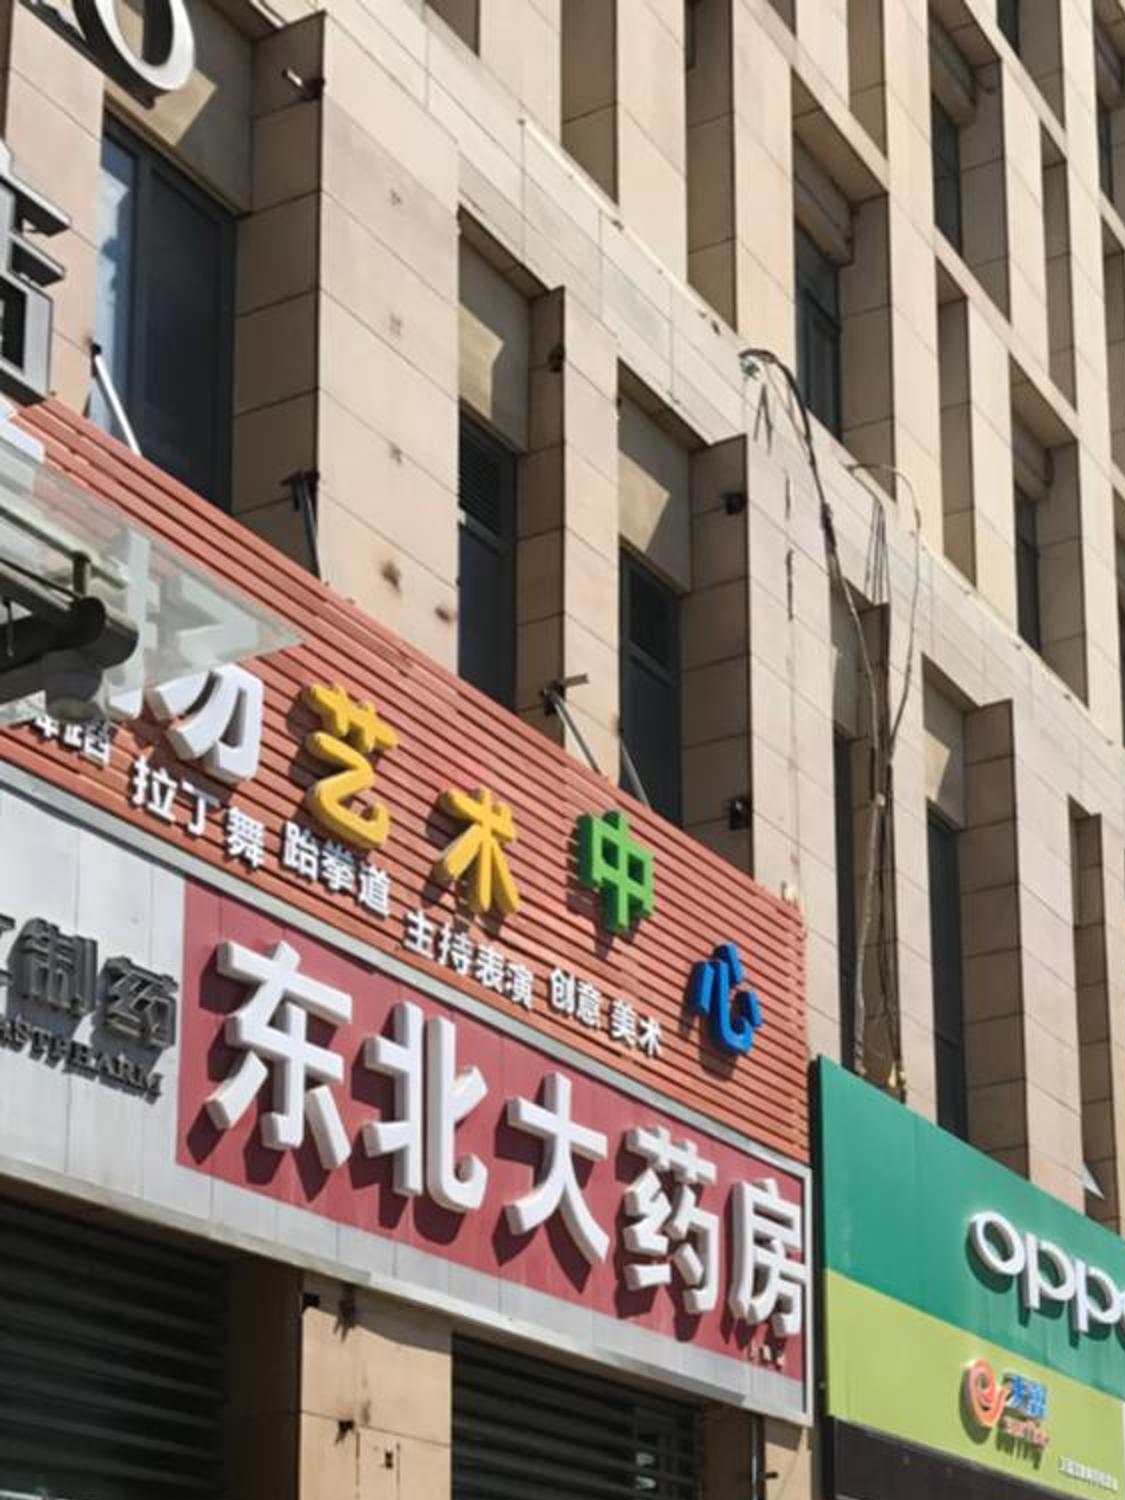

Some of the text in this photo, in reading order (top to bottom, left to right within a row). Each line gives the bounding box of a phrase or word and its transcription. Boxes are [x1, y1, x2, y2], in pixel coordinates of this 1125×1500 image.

[0, 912, 179, 1050] 制药
[132, 755, 267, 868] 拉丁舞
[404, 908, 534, 1011] 主持表演
[549, 967, 602, 1030] 创意
[205, 940, 808, 1338] 东北大药房
